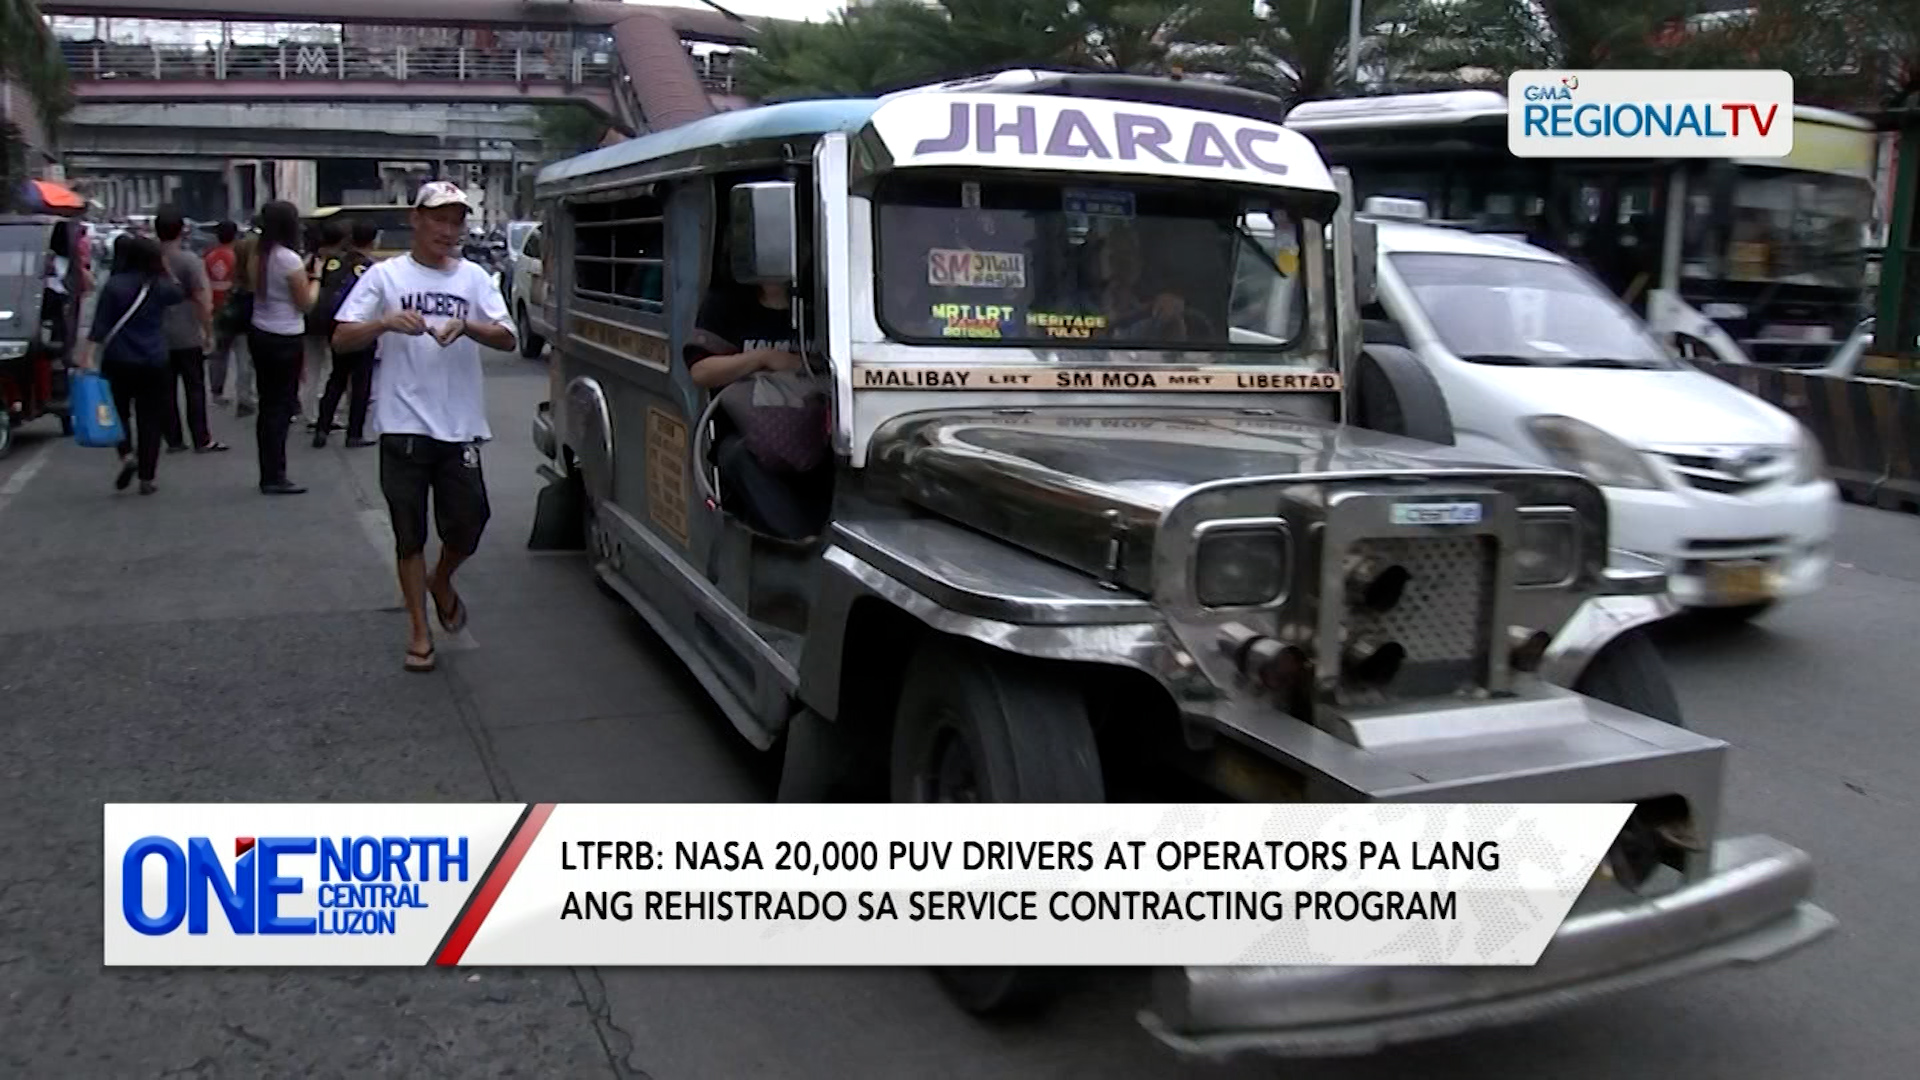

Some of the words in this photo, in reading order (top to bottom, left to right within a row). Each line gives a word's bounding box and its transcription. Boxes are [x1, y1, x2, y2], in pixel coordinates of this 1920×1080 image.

[914, 101, 1289, 176] JHARAC
[931, 252, 972, 284] SM
[932, 303, 971, 319] MRT
[975, 304, 1014, 321] LRT
[1026, 314, 1106, 328] HERITAGE
[865, 370, 970, 387] MALIBAY
[989, 374, 1032, 384] LRT
[1056, 372, 1093, 387] SM
[1102, 373, 1157, 388] MOA
[1168, 375, 1215, 384] MRT
[1237, 375, 1335, 389] LIBERTAD
